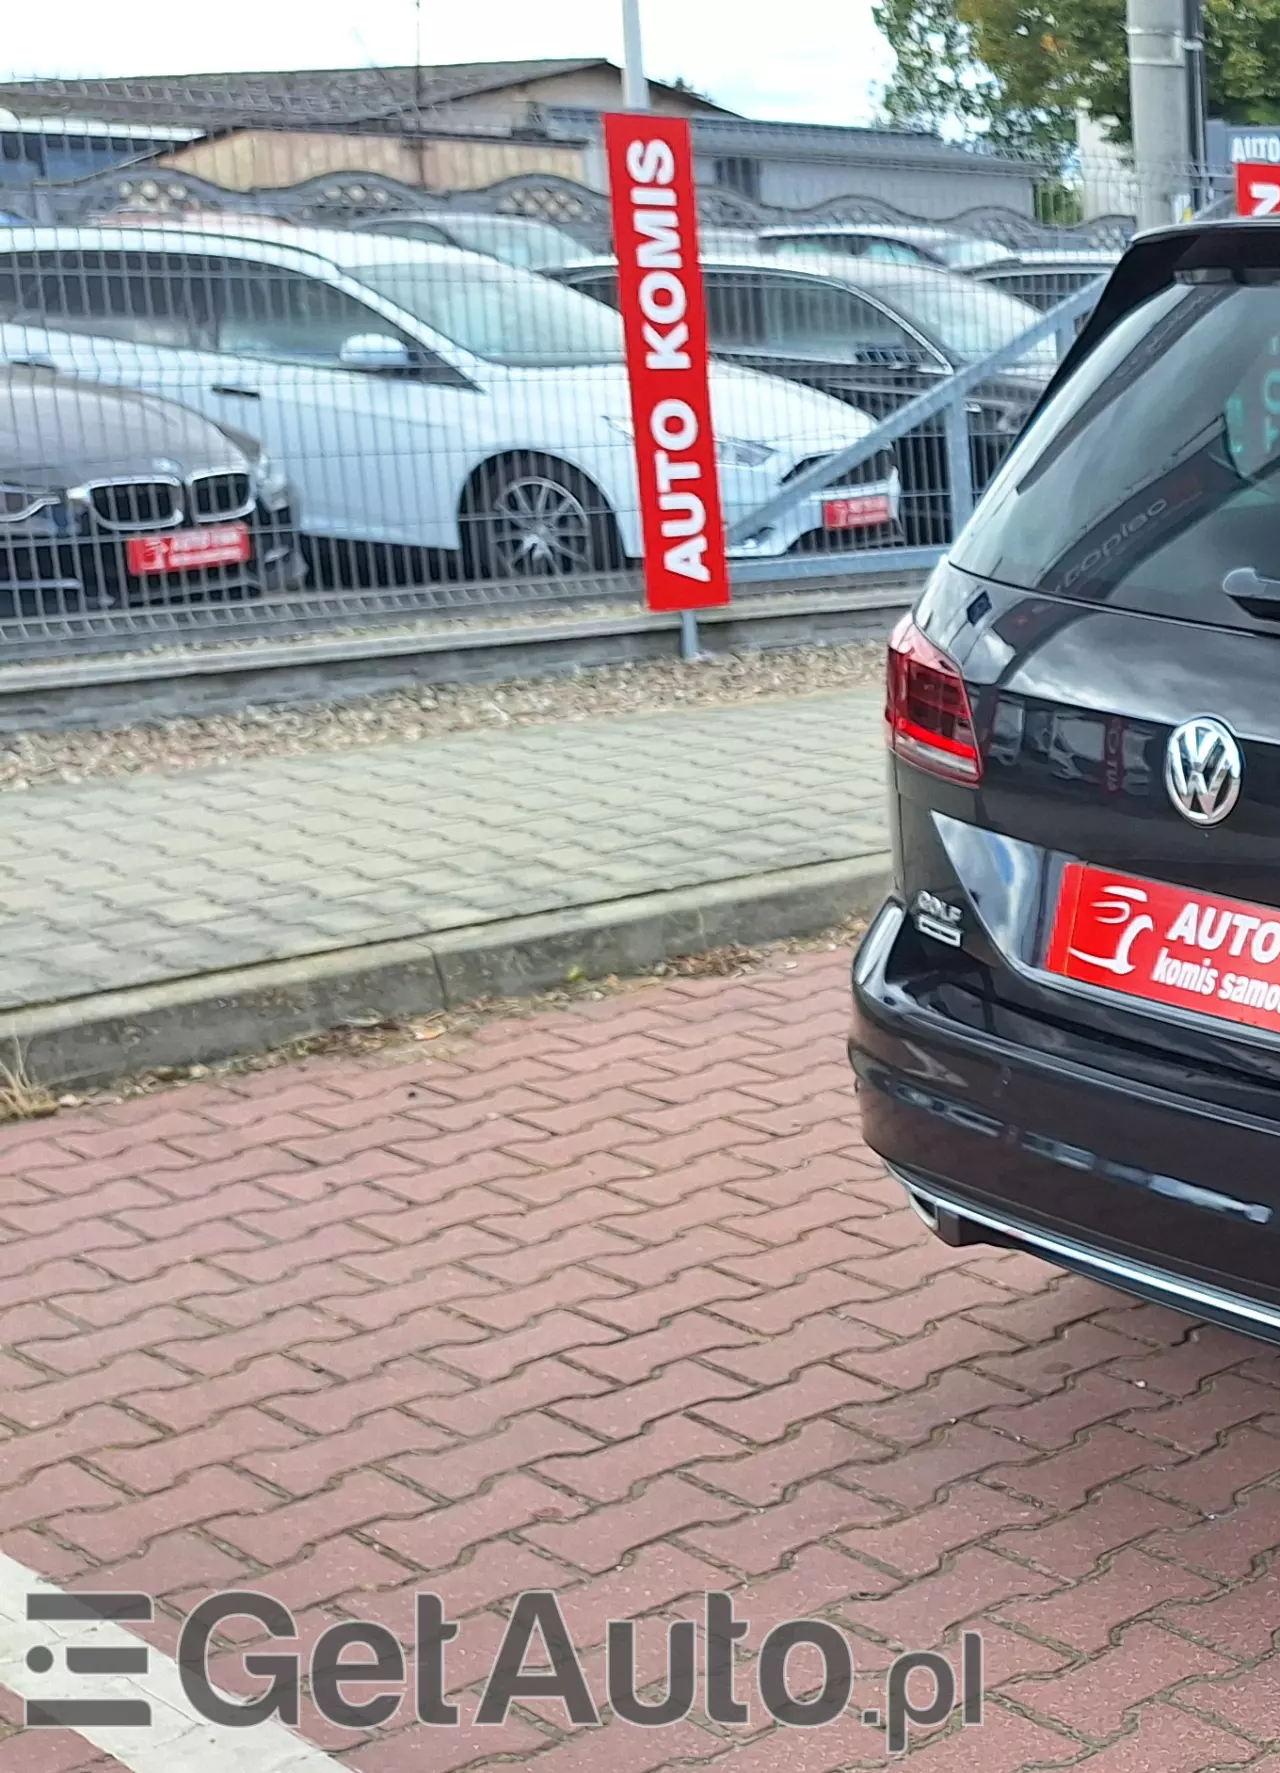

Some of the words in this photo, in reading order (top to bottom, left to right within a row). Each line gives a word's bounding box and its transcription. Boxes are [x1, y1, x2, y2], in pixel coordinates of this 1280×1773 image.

[1231, 135, 1280, 163] AUTO
[626, 137, 692, 370] KOMIS
[650, 398, 711, 583] AUTO
[1152, 946, 1219, 998] komis
